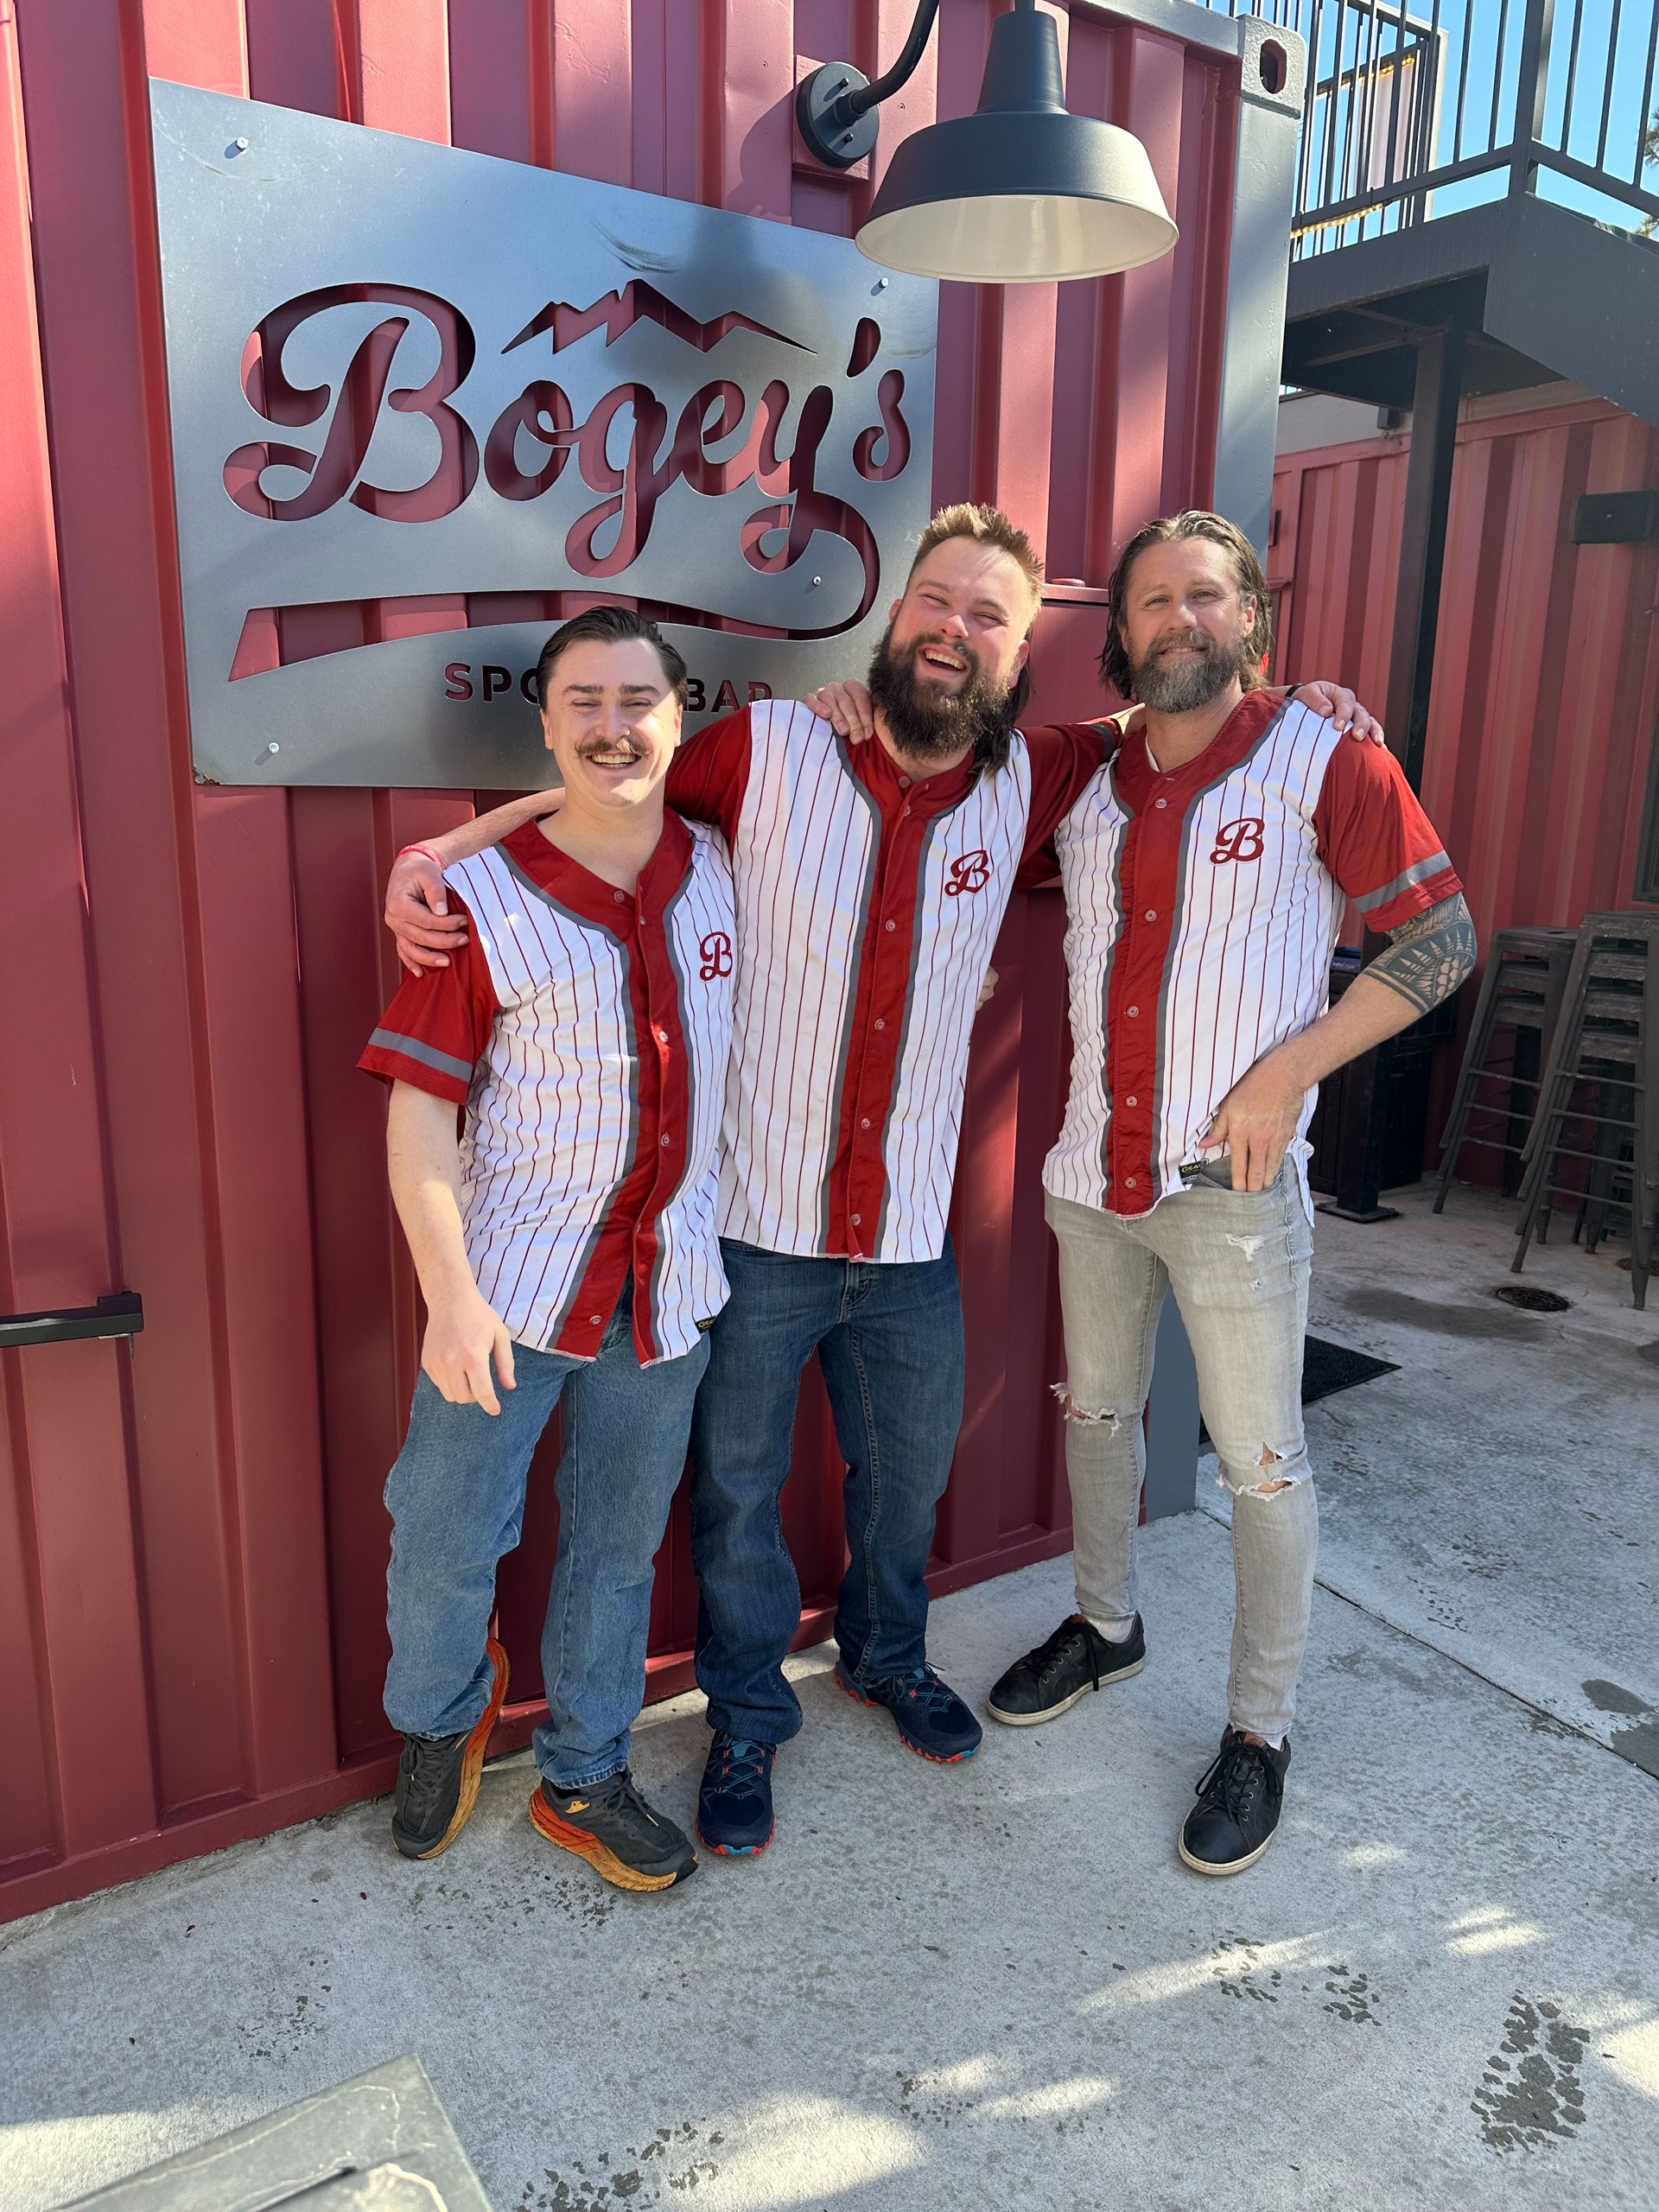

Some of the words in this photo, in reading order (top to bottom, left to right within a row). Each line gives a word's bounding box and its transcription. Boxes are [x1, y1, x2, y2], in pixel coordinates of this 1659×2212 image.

[222, 283, 912, 579] Bogey's
[1210, 817, 1265, 865] B
[944, 849, 990, 897] B
[699, 931, 734, 982] B
